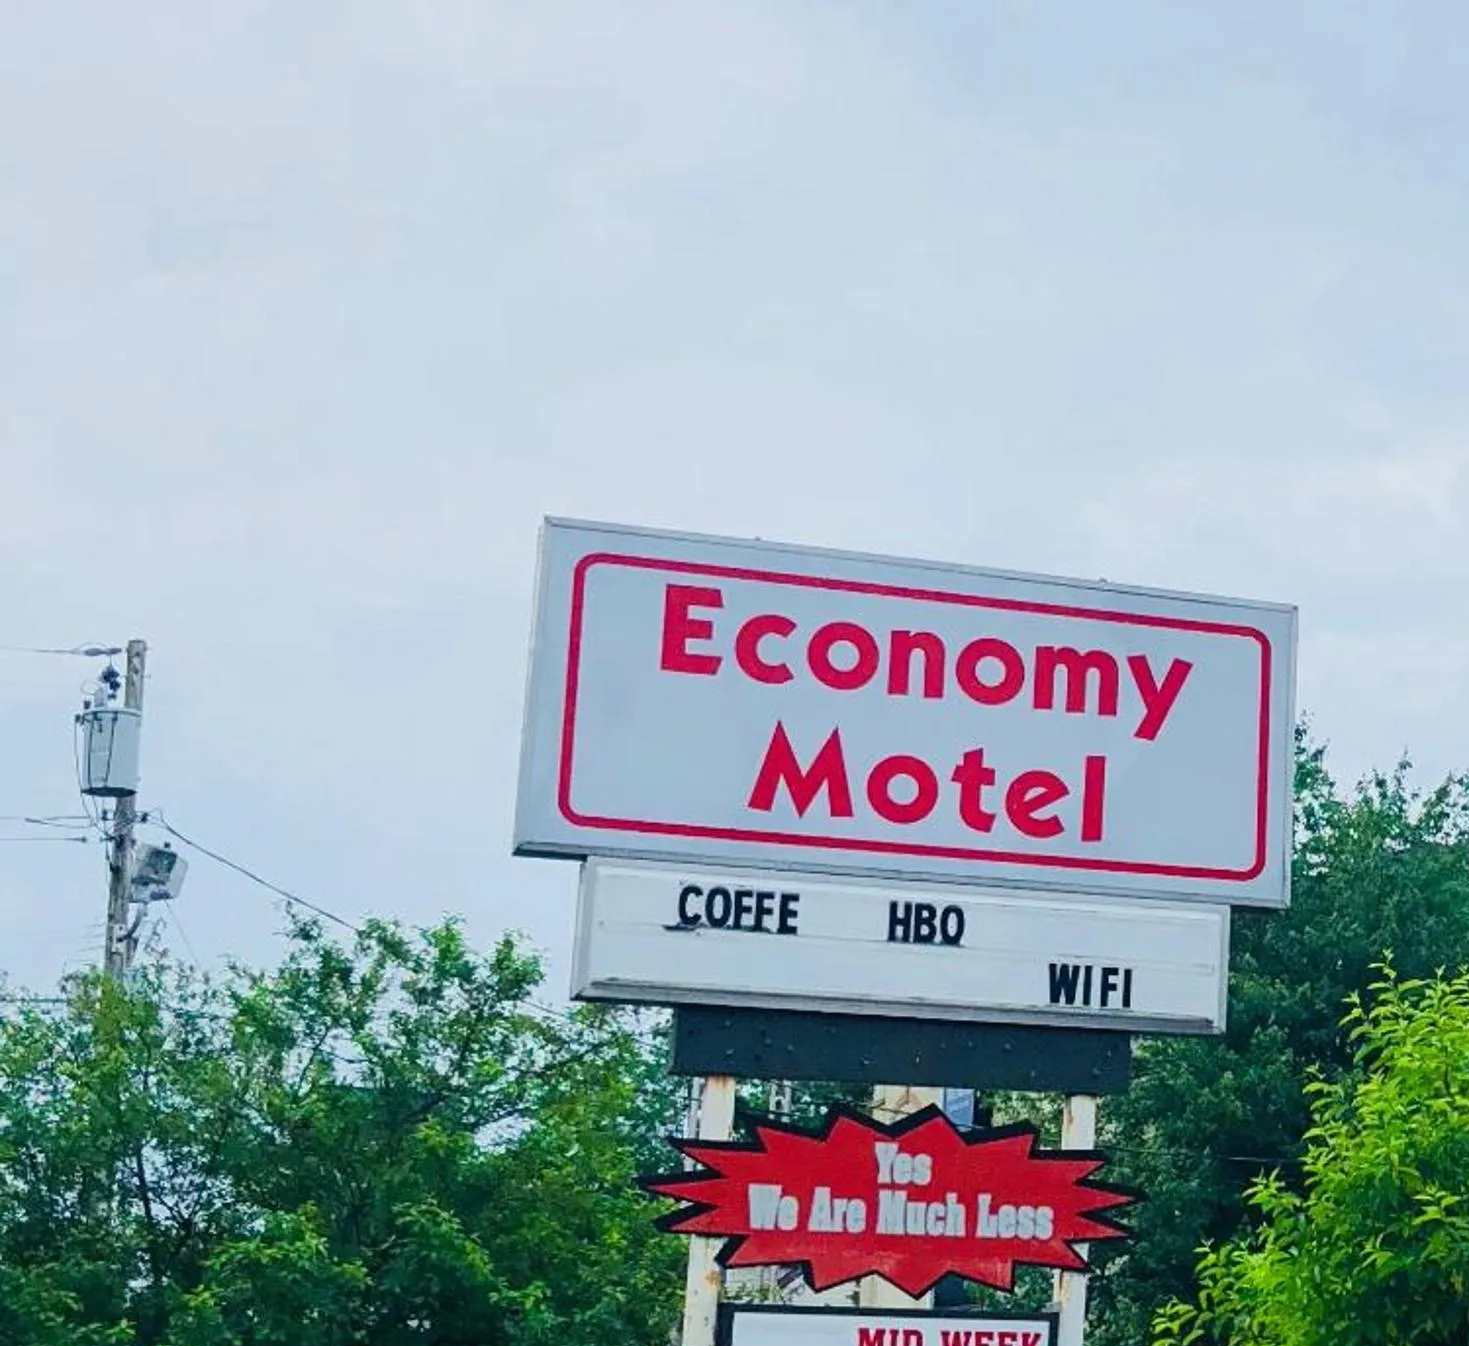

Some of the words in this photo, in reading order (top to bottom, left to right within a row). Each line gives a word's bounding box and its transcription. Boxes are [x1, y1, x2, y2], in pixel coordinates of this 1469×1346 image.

[660, 583, 1193, 741] Economy
[748, 720, 1106, 843] Motel
[678, 885, 799, 935] COFFE
[887, 901, 964, 946] HBO
[1049, 963, 1132, 1009] WIFI
[875, 1142, 932, 1185] Yes
[748, 1184, 799, 1231] We
[808, 1186, 866, 1233] Are
[875, 1189, 966, 1237] Much
[975, 1193, 1054, 1241] Less
